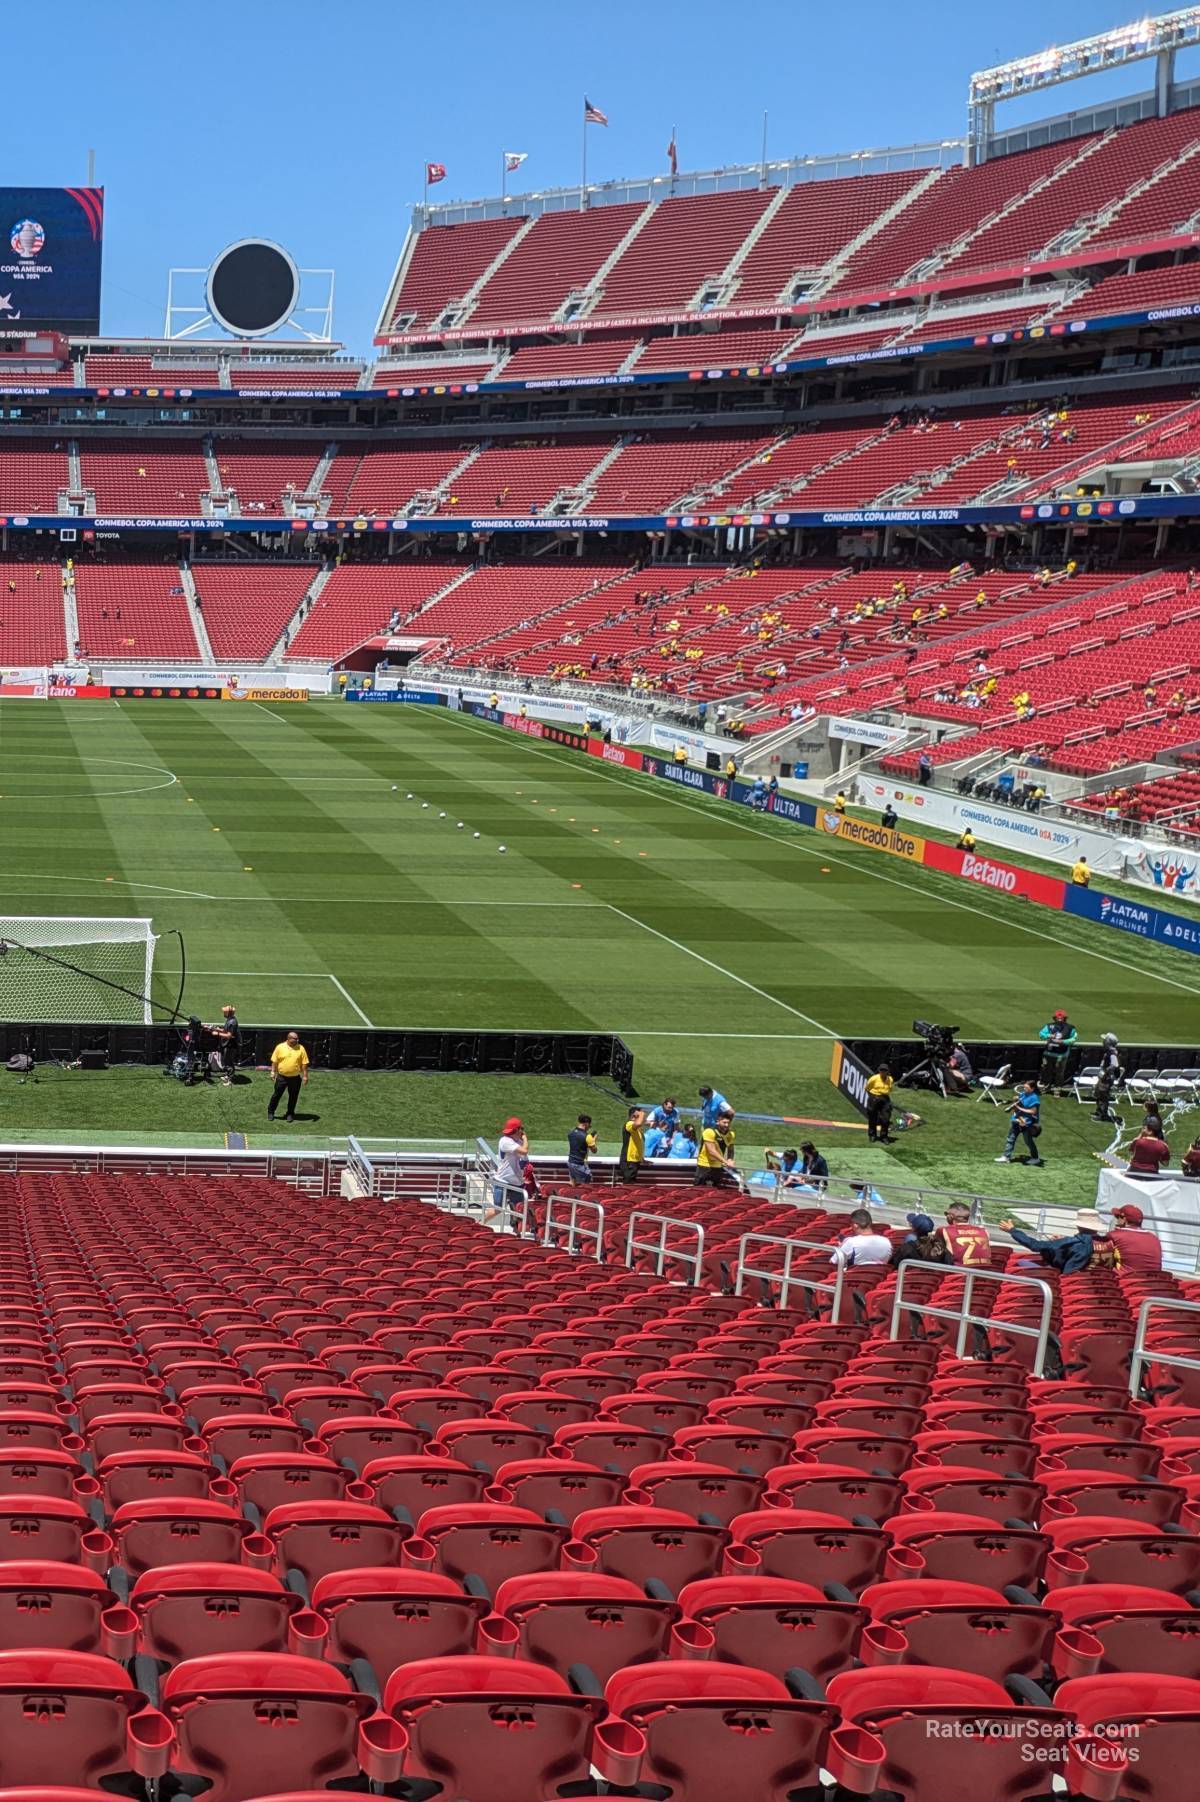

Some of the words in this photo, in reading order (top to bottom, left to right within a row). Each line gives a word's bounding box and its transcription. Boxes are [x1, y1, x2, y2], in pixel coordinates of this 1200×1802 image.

[0, 265, 20, 273] COPA
[20, 265, 53, 273] AMERICA
[1147, 304, 1193, 321] CONMEBOL
[503, 328, 518, 336] TEXT
[638, 316, 666, 325] INCLUDE
[739, 309, 755, 317] AND
[6, 330, 37, 338] STADIUM
[94, 519, 136, 527] CONMEBOL
[136, 519, 157, 528] COPA
[156, 519, 190, 528] AMERICA
[191, 520, 205, 528] USA
[206, 520, 224, 528] 2024
[471, 520, 514, 529] CONMEBOL
[514, 519, 535, 528] COPA
[535, 519, 571, 528] AMERICA
[572, 519, 587, 528] USA
[588, 518, 609, 527] 2024
[822, 512, 864, 523] CONMEBOL
[863, 511, 886, 522] COPA
[885, 510, 920, 521] AMERICA
[921, 510, 937, 520] USA
[938, 510, 959, 520] 2024
[251, 689, 299, 699] mercado
[834, 725, 856, 735] CONMEBOL
[856, 728, 869, 737] COPA
[869, 730, 888, 741] AMERICA
[602, 743, 625, 764] Betano
[664, 764, 683, 781] SANTA
[684, 771, 704, 788] CLARA
[774, 798, 801, 819] ULTRA
[960, 808, 993, 825] CONMEBOL
[993, 816, 1010, 829] COPA
[1010, 819, 1038, 837] AMERICA
[1039, 828, 1052, 841] USA
[1052, 831, 1069, 844] 2024
[841, 818, 888, 848] mercado
[889, 829, 915, 856] libre
[960, 853, 1016, 891] Betano
[1112, 902, 1148, 923] LATAM
[1110, 916, 1148, 935] AIRLINES
